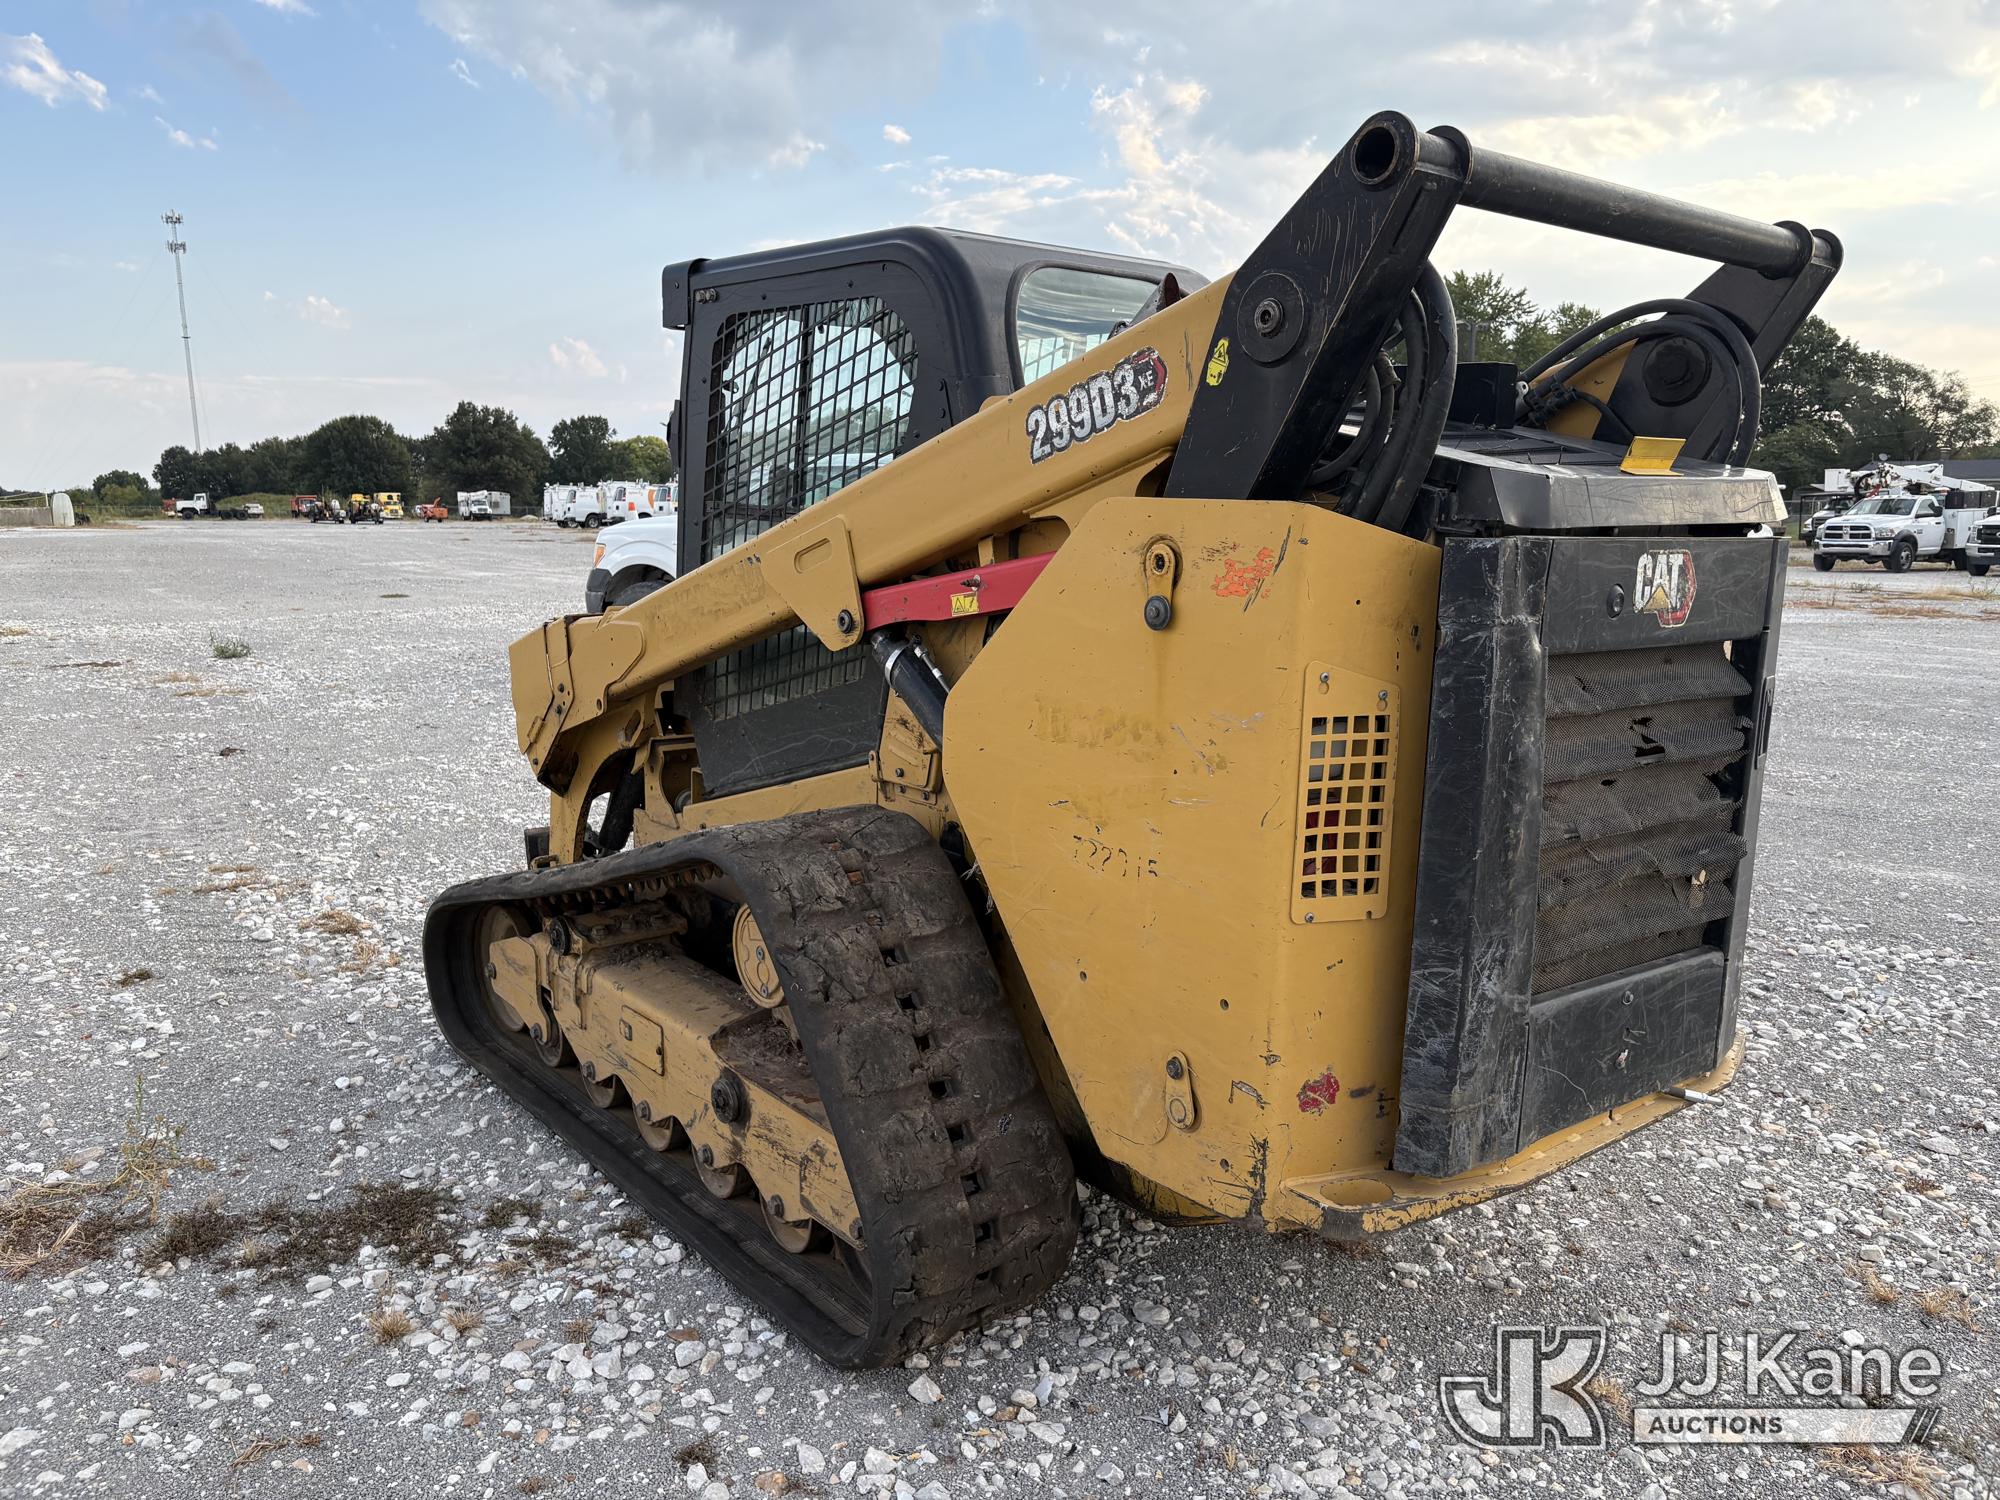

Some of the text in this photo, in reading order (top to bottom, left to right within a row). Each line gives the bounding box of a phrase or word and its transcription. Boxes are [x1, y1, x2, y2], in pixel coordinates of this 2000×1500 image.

[1027, 363, 1154, 461] 299D3 XE
[1634, 552, 1684, 613] CAT
